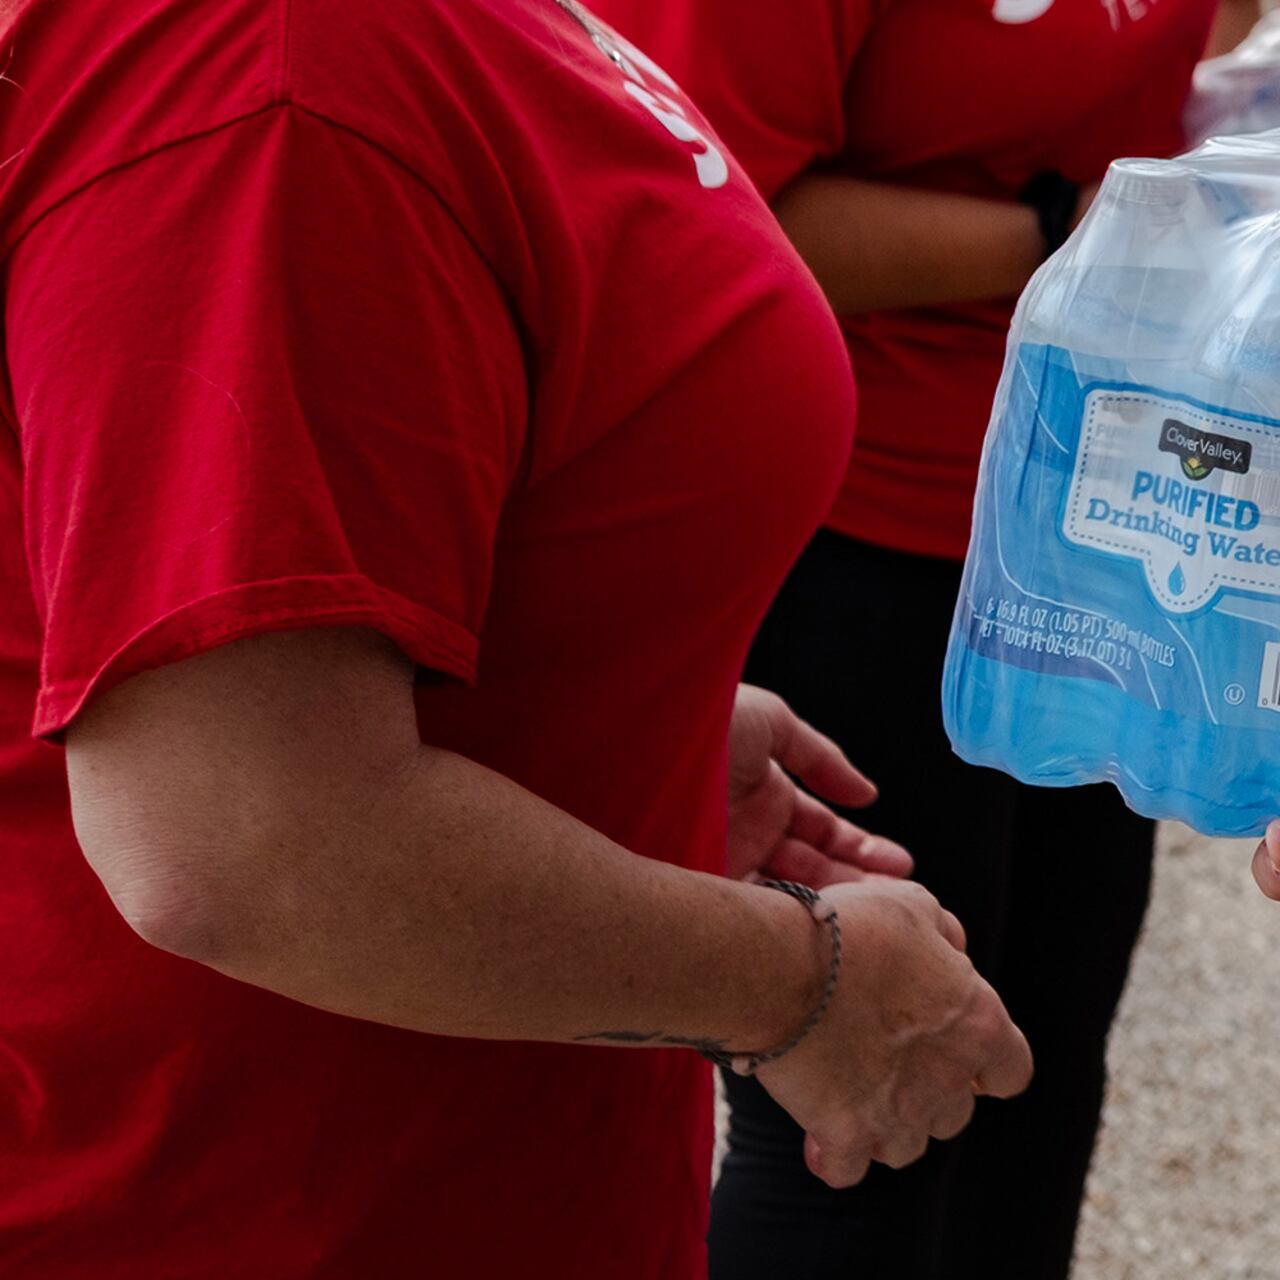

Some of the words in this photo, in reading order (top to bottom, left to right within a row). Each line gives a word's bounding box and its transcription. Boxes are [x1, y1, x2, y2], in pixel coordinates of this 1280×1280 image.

[1085, 497, 1200, 557] Drinking
[1131, 470, 1261, 532] PURIFIED
[1081, 615, 1103, 639] PT)
[1105, 619, 1127, 642] 500
